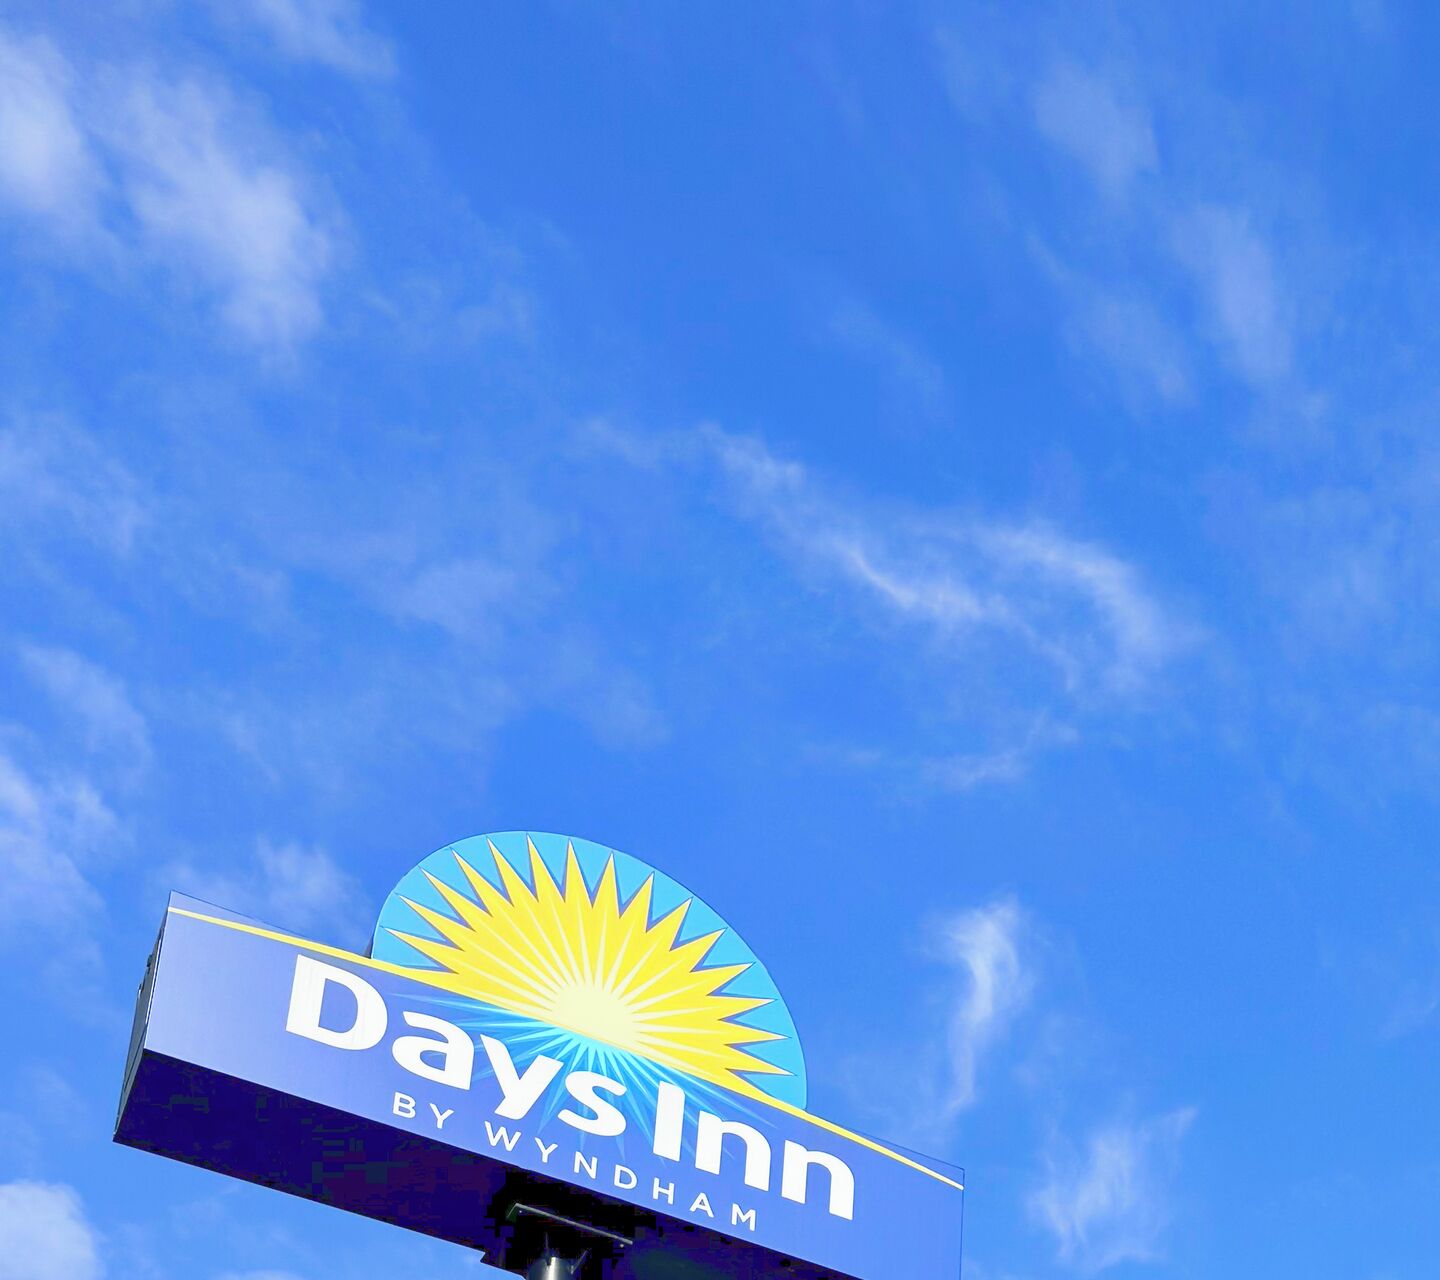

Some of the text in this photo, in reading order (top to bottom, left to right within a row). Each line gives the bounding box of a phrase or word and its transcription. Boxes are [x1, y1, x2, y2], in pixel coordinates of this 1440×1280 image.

[286, 955, 855, 1221] Days Inn
[392, 1092, 758, 1231] BY WYNDHAM
